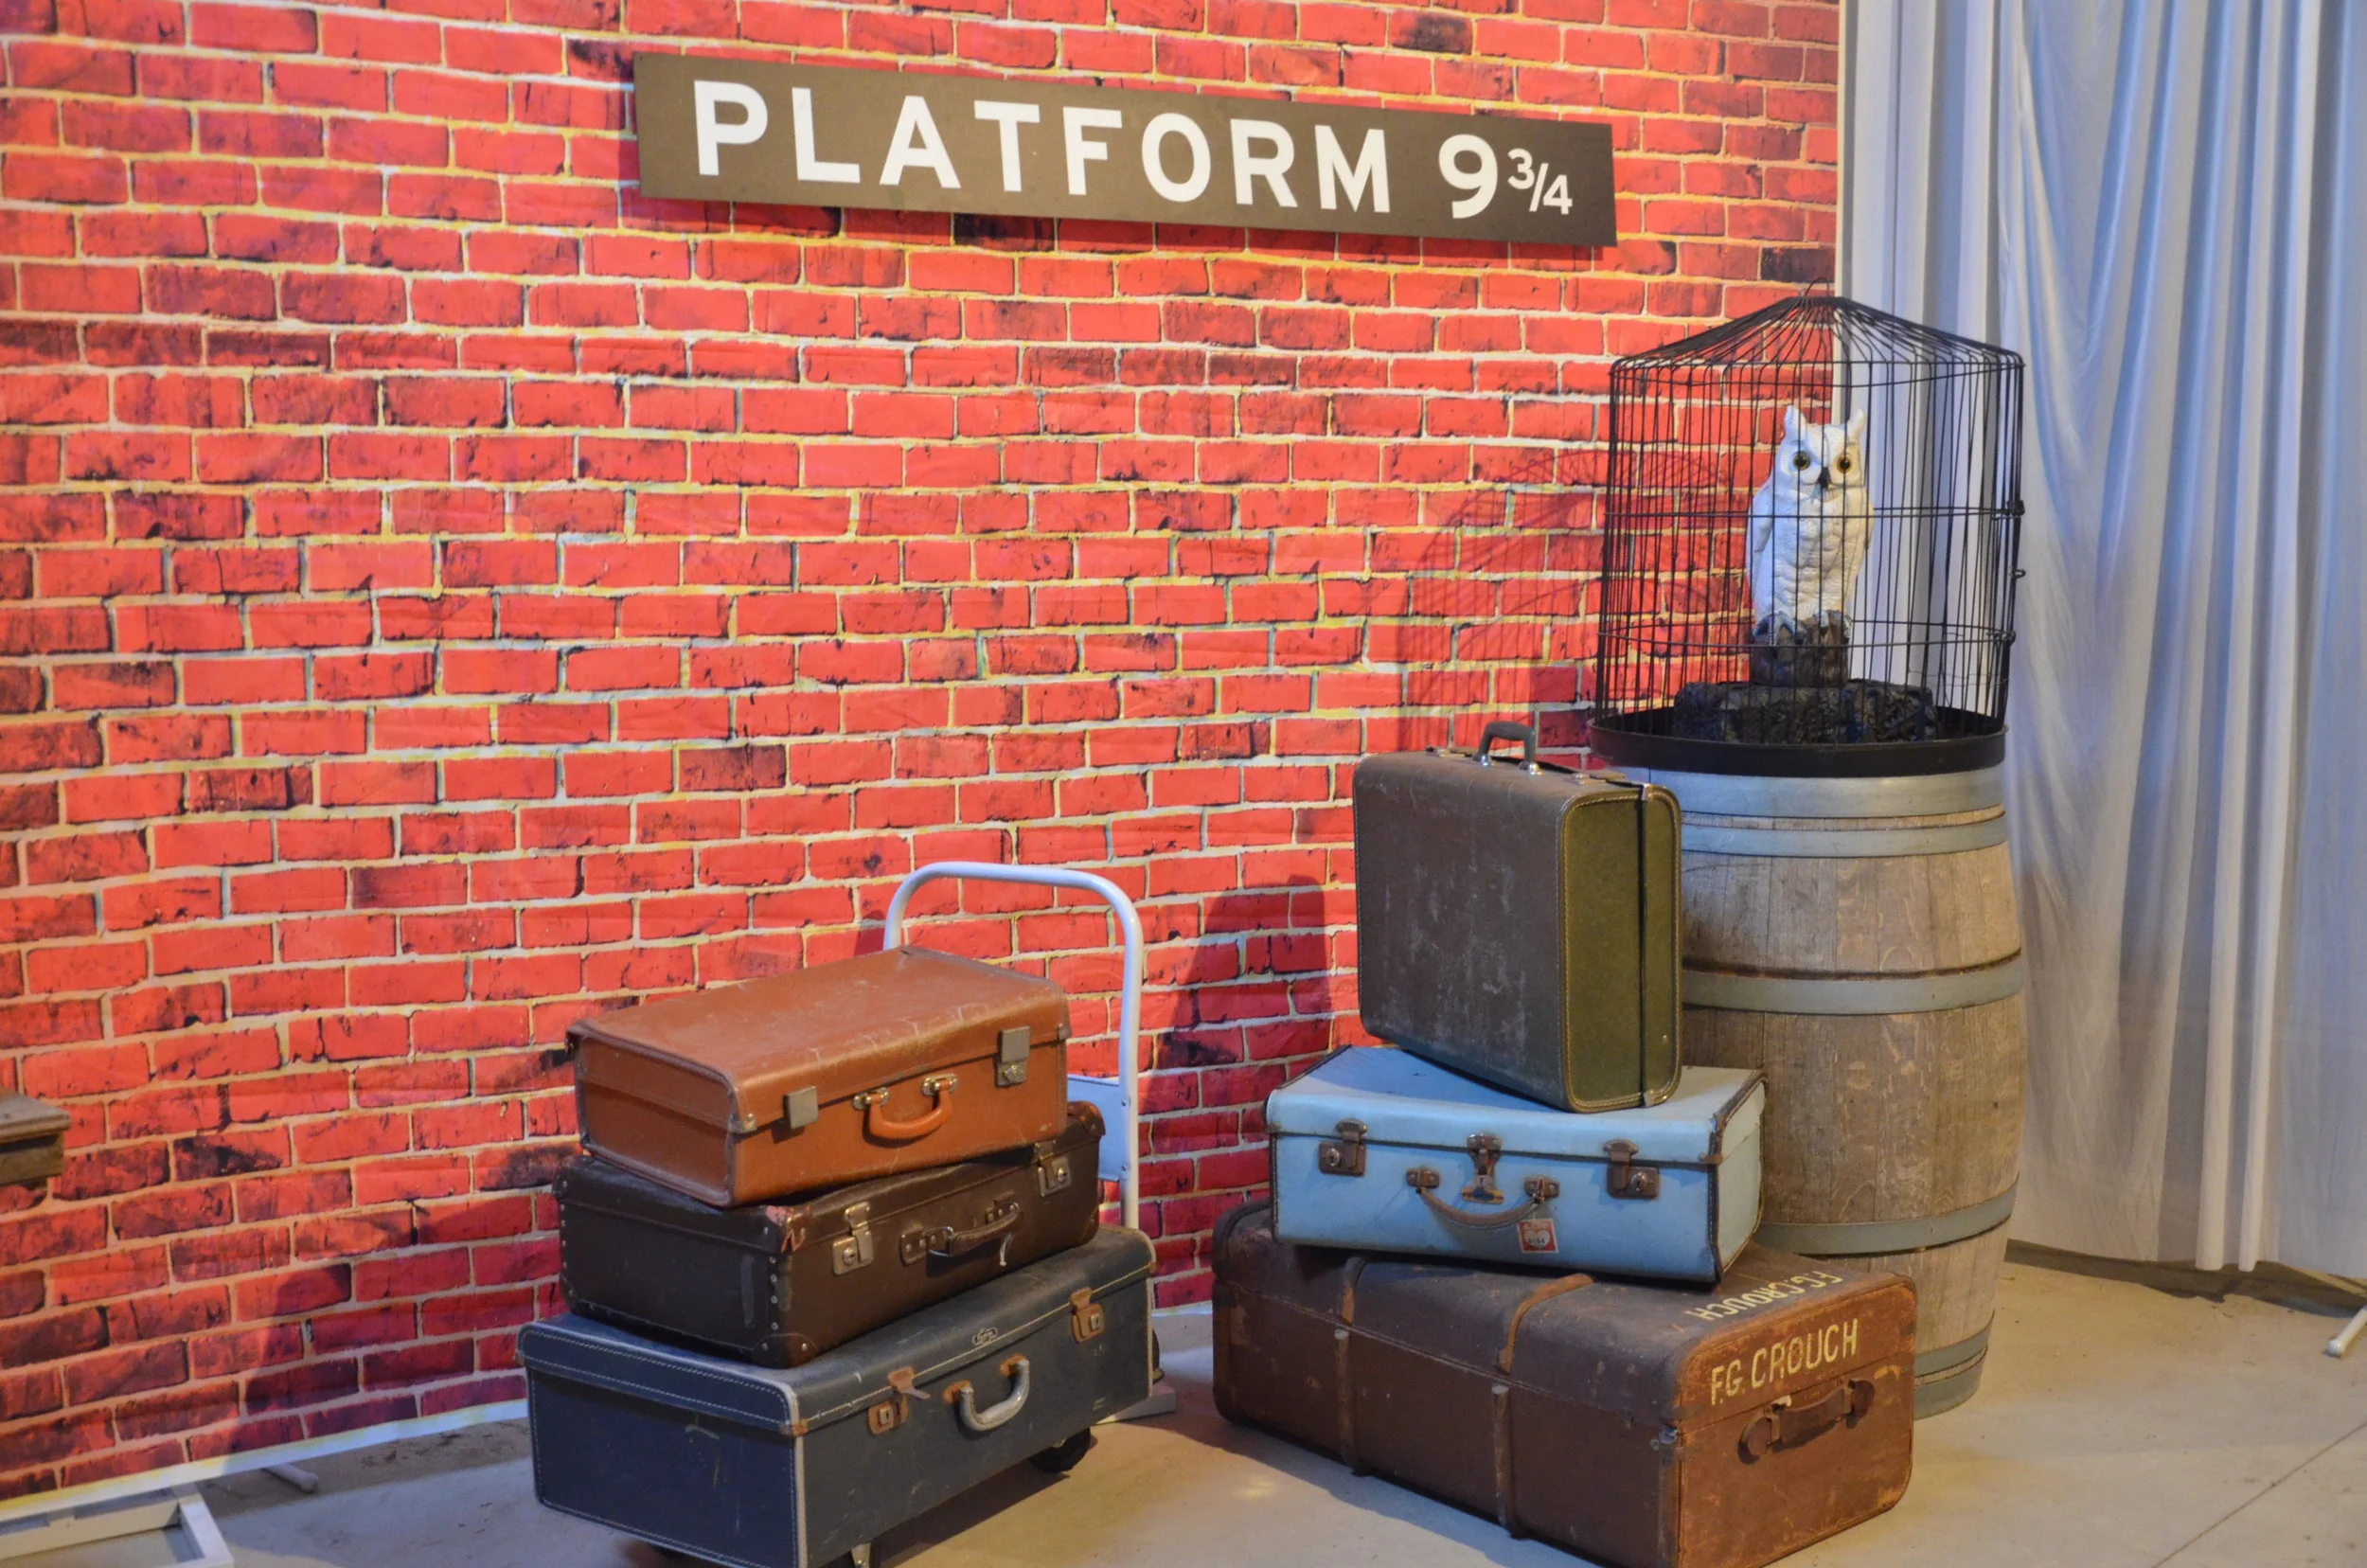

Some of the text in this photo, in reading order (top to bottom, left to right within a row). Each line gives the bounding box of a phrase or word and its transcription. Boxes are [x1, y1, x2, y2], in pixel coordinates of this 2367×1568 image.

[694, 80, 1391, 214] PLATFORM
[1682, 1281, 1806, 1321] CROUCH
[1752, 1318, 1859, 1389] CROUCH
